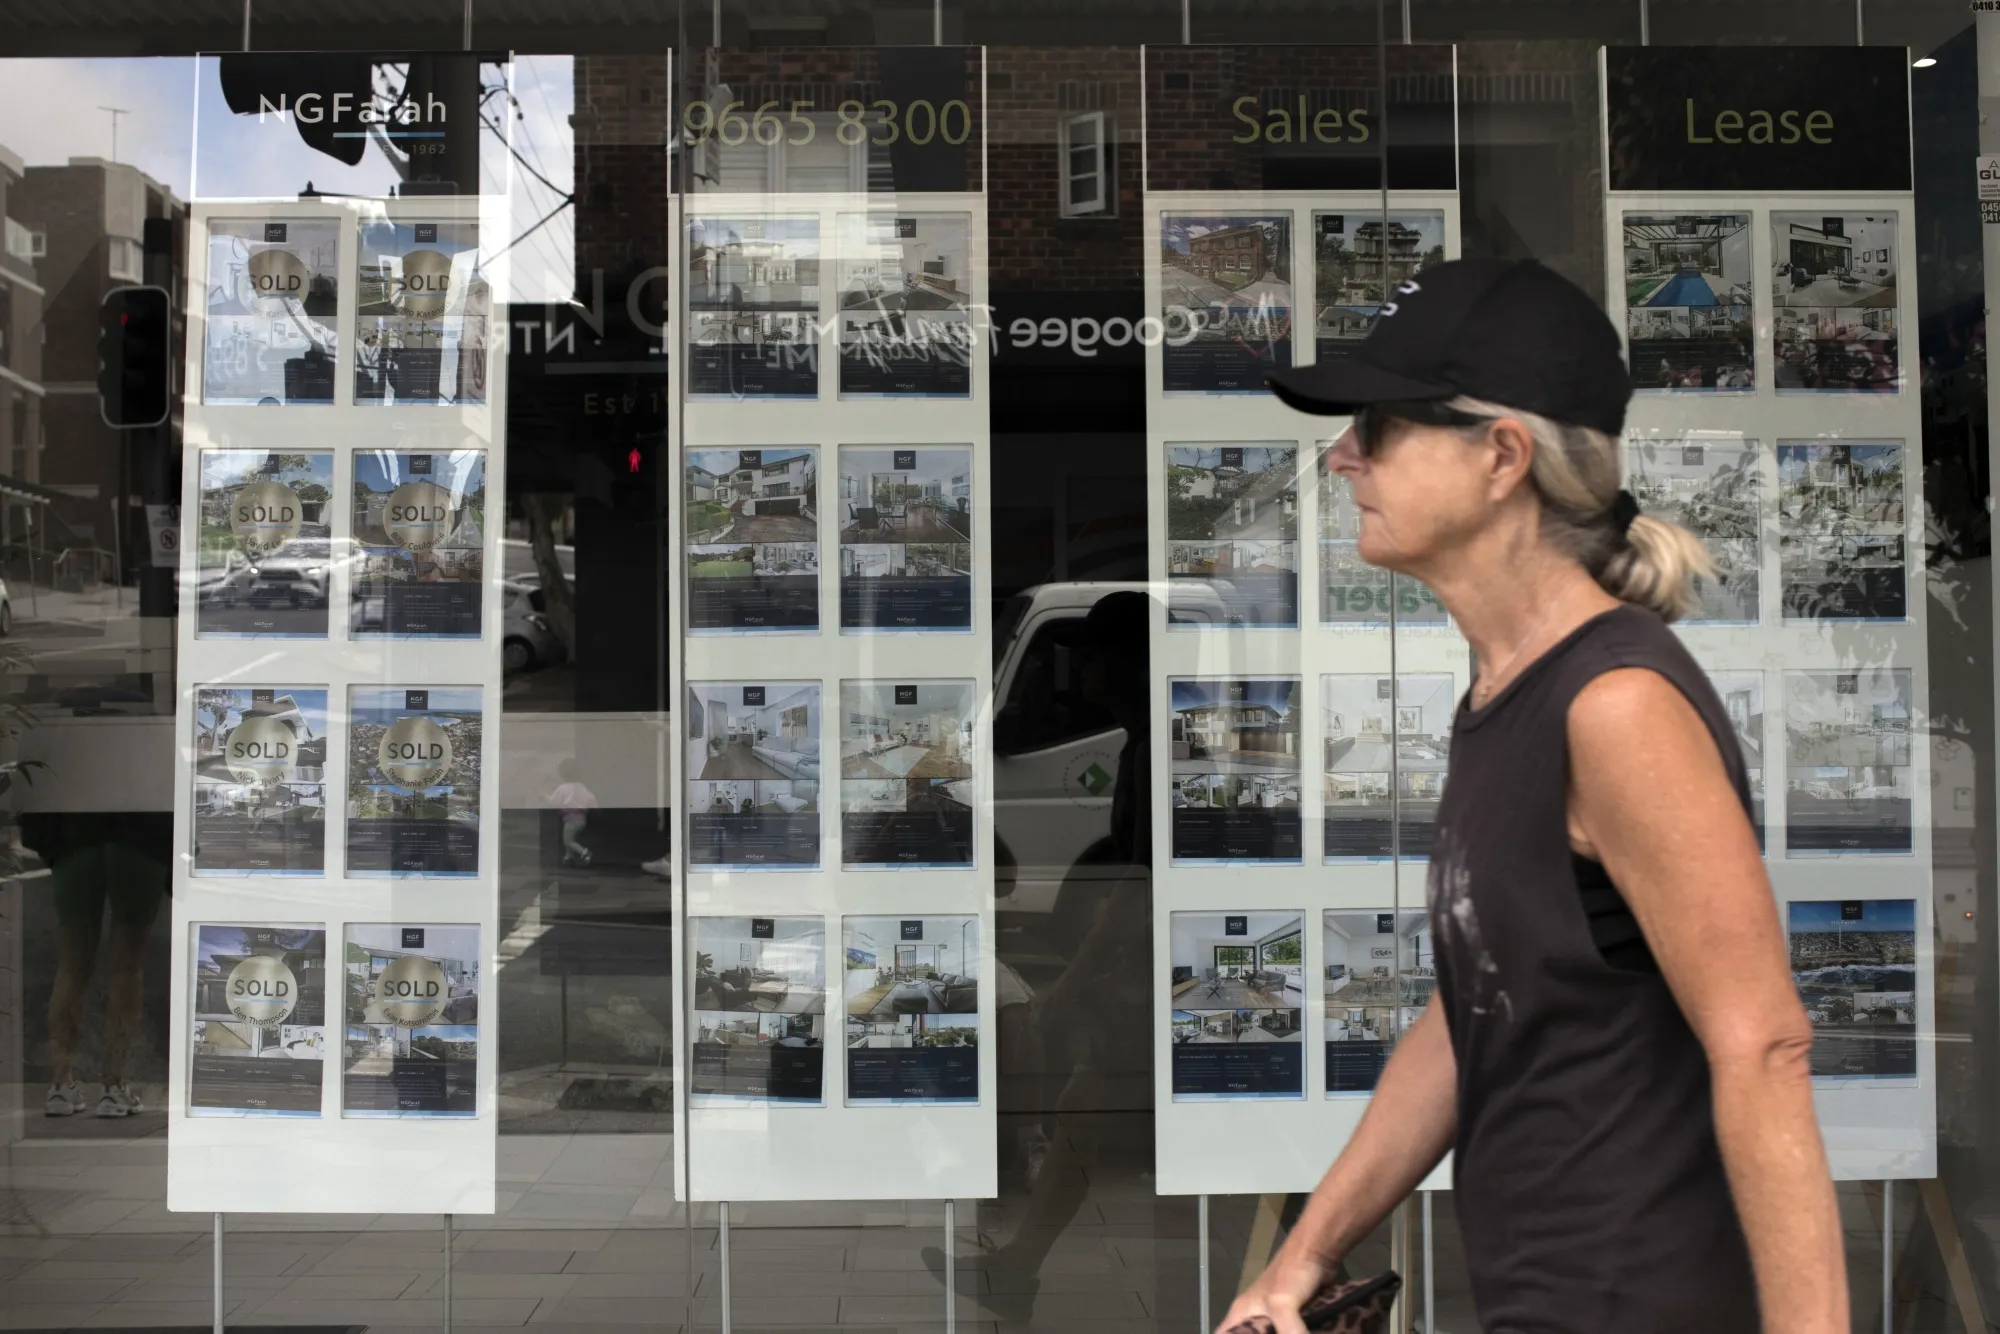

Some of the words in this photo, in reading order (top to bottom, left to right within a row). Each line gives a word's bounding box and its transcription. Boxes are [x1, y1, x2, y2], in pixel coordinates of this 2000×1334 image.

[259, 92, 446, 124] NGFarah
[684, 100, 816, 146] 9665
[836, 99, 971, 145] 8300
[1231, 94, 1369, 144] Sales
[1686, 97, 1834, 144] Lease
[1981, 202, 2000, 212] 045
[1982, 212, 2000, 222] 041
[247, 275, 301, 291] SOLD
[239, 506, 294, 522] SOLD
[391, 506, 446, 521] SOLD
[390, 531, 407, 548] Billy
[234, 742, 289, 759] SOLD
[387, 743, 443, 760] SOLD
[237, 771, 256, 786] Nick
[386, 767, 422, 787] Stephanie
[423, 768, 445, 786] Farah
[234, 979, 289, 997] SOLD
[383, 980, 440, 997] SOLD
[234, 1006, 247, 1021] Ben
[249, 1007, 288, 1026] Thompson
[383, 1007, 398, 1023] Evan
